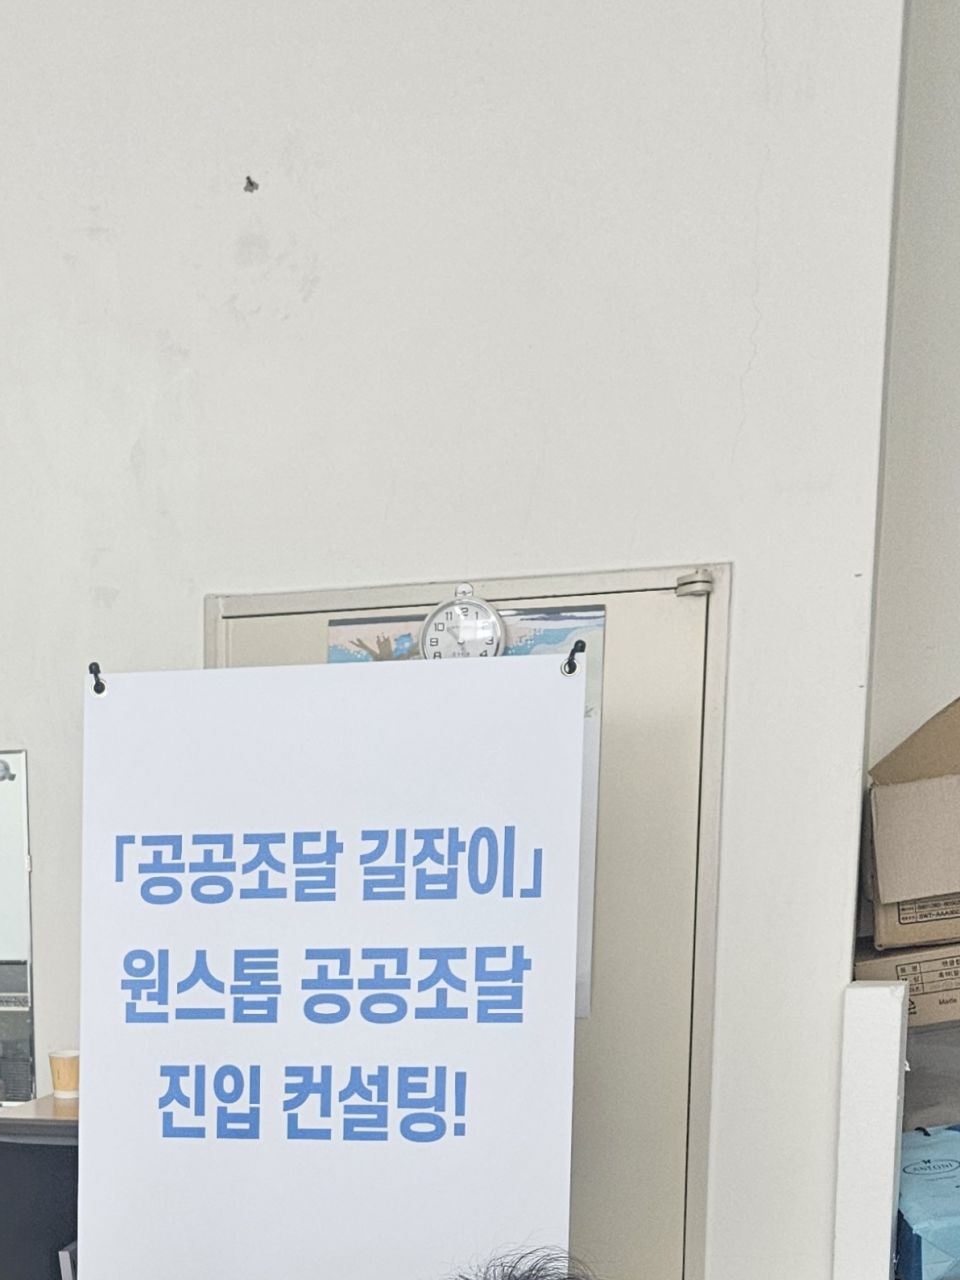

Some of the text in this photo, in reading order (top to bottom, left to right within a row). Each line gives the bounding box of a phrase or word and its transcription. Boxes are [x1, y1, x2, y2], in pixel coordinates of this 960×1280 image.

[116, 826, 542, 905] 「공공조달 길잡이」
[121, 945, 531, 1024] 원스톱 공공조달
[159, 1064, 466, 1142] 진입 컨설팅!
